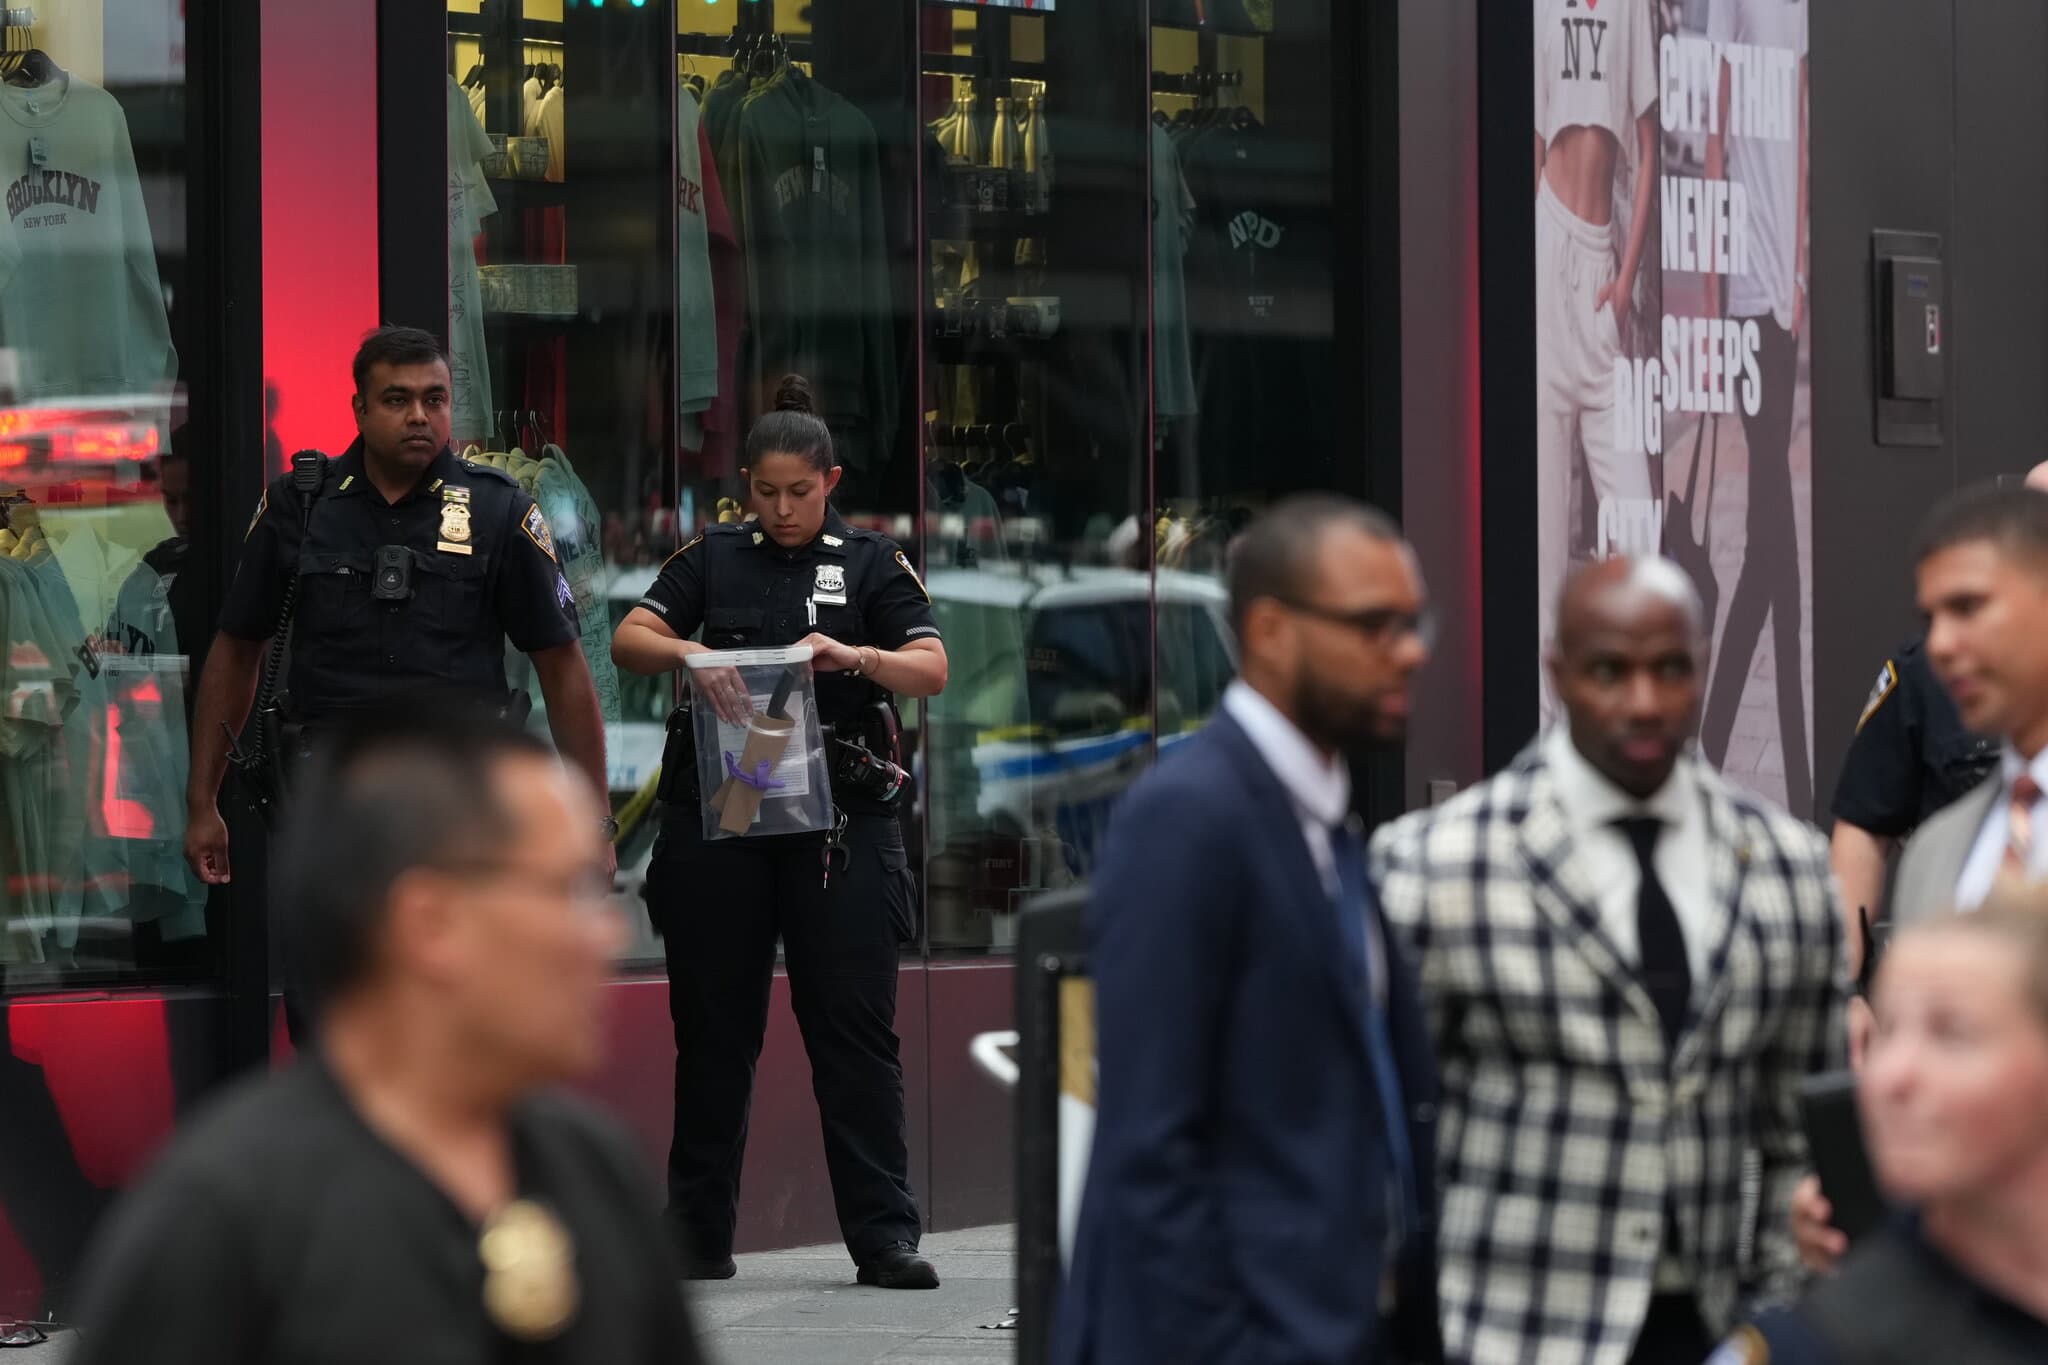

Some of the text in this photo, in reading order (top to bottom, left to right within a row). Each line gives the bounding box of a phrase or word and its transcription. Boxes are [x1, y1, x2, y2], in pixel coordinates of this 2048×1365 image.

[1561, 17, 1608, 81] NY
[1660, 33, 1796, 141] CITY THAT
[6, 169, 101, 224] BROOKLYN
[23, 213, 68, 229] NEW YORK
[1660, 175, 1748, 275] NEVER
[1613, 356, 1662, 455] BIG
[1661, 314, 1761, 417] SLEEPS
